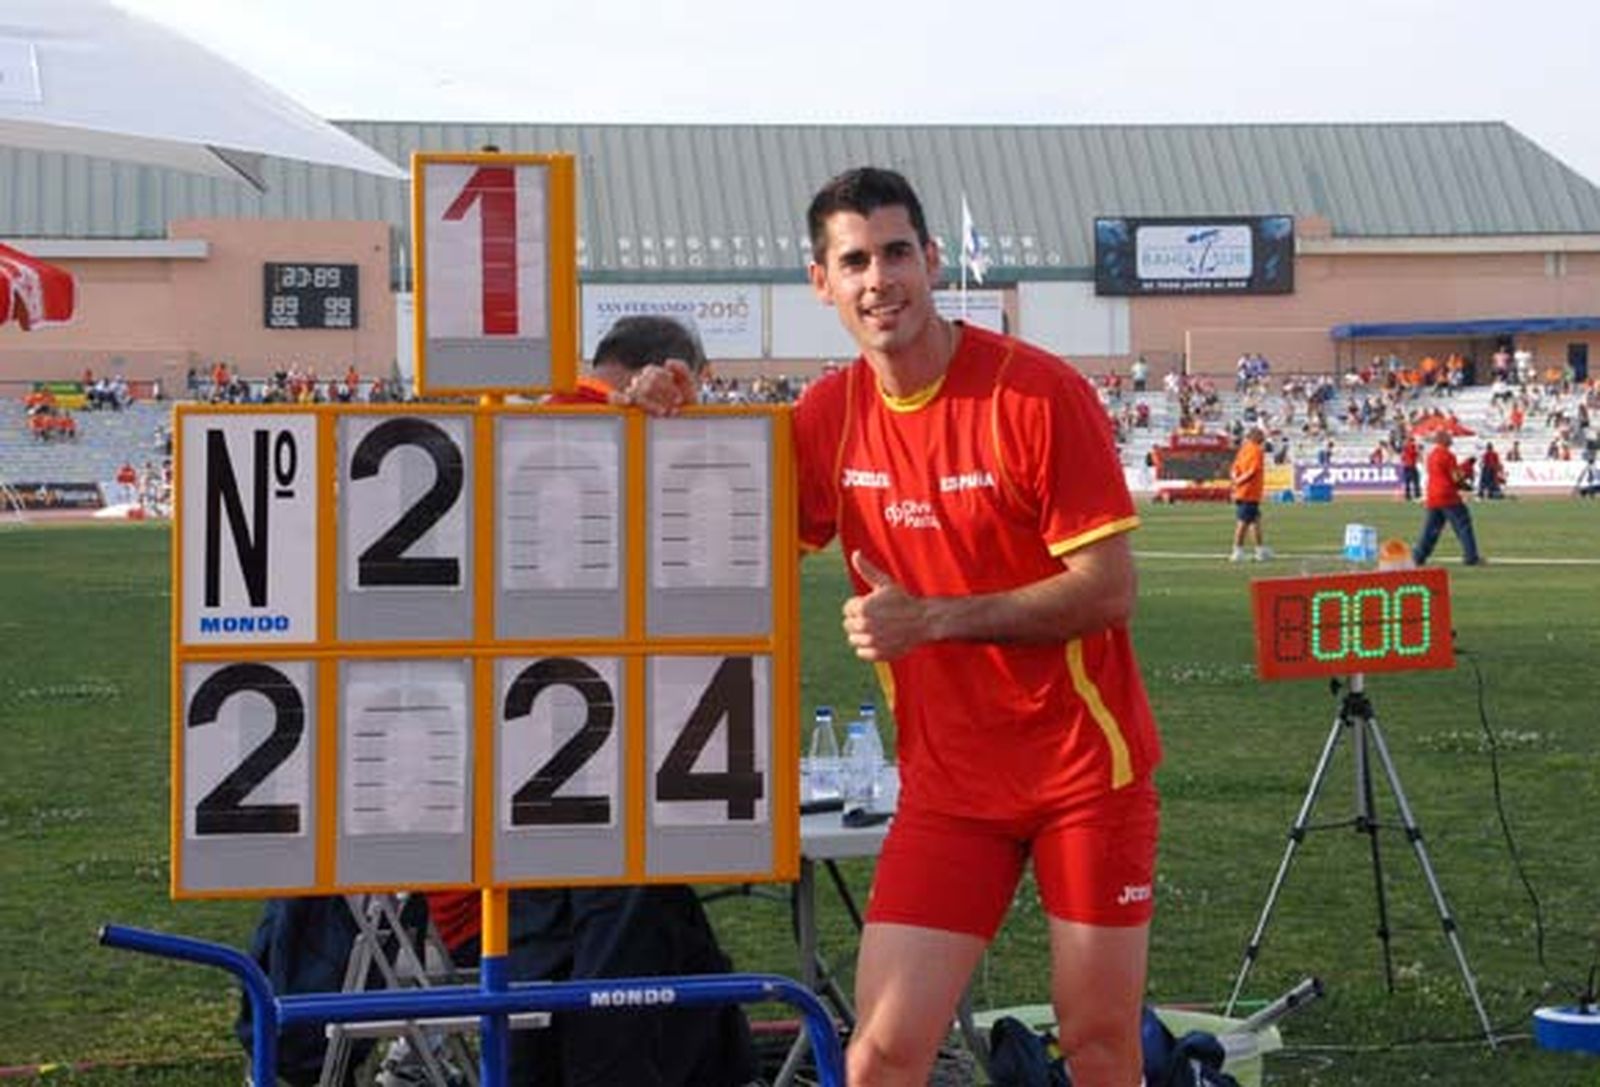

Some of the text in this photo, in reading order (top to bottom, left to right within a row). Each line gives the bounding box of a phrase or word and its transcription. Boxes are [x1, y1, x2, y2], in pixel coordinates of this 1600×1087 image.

[442, 166, 518, 335] 1
[698, 301, 749, 319] 2010
[350, 417, 464, 587] 2
[200, 615, 289, 632] MONDO
[590, 987, 676, 1006] MONDO
